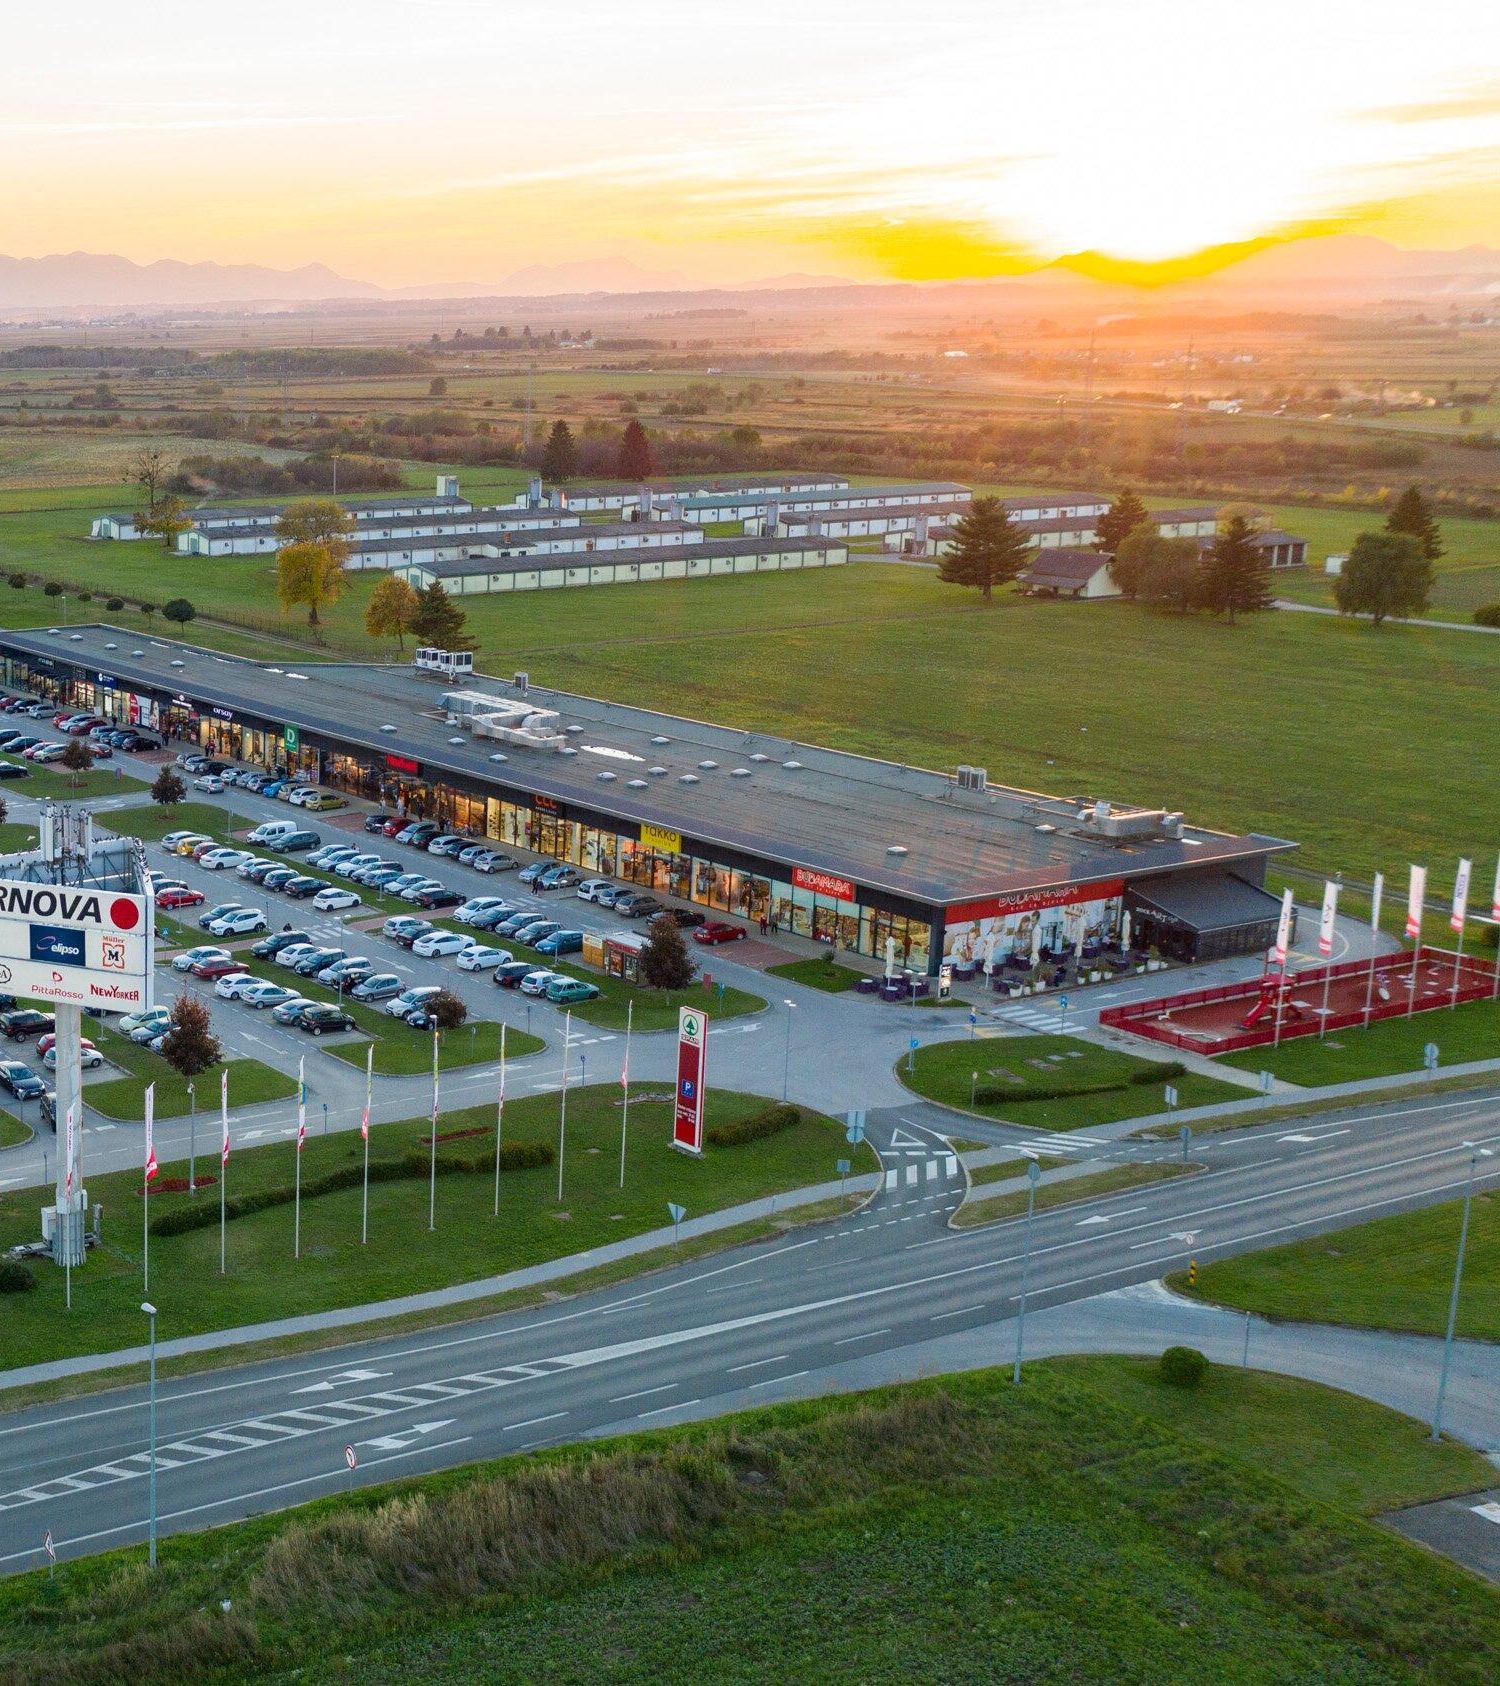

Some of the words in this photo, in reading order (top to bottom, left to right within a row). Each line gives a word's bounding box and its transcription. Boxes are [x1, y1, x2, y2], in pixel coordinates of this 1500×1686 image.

[213, 707, 233, 720] orsay
[102, 935, 125, 944] Müller
[51, 943, 80, 955] elipso
[31, 984, 84, 999] PittaRosso
